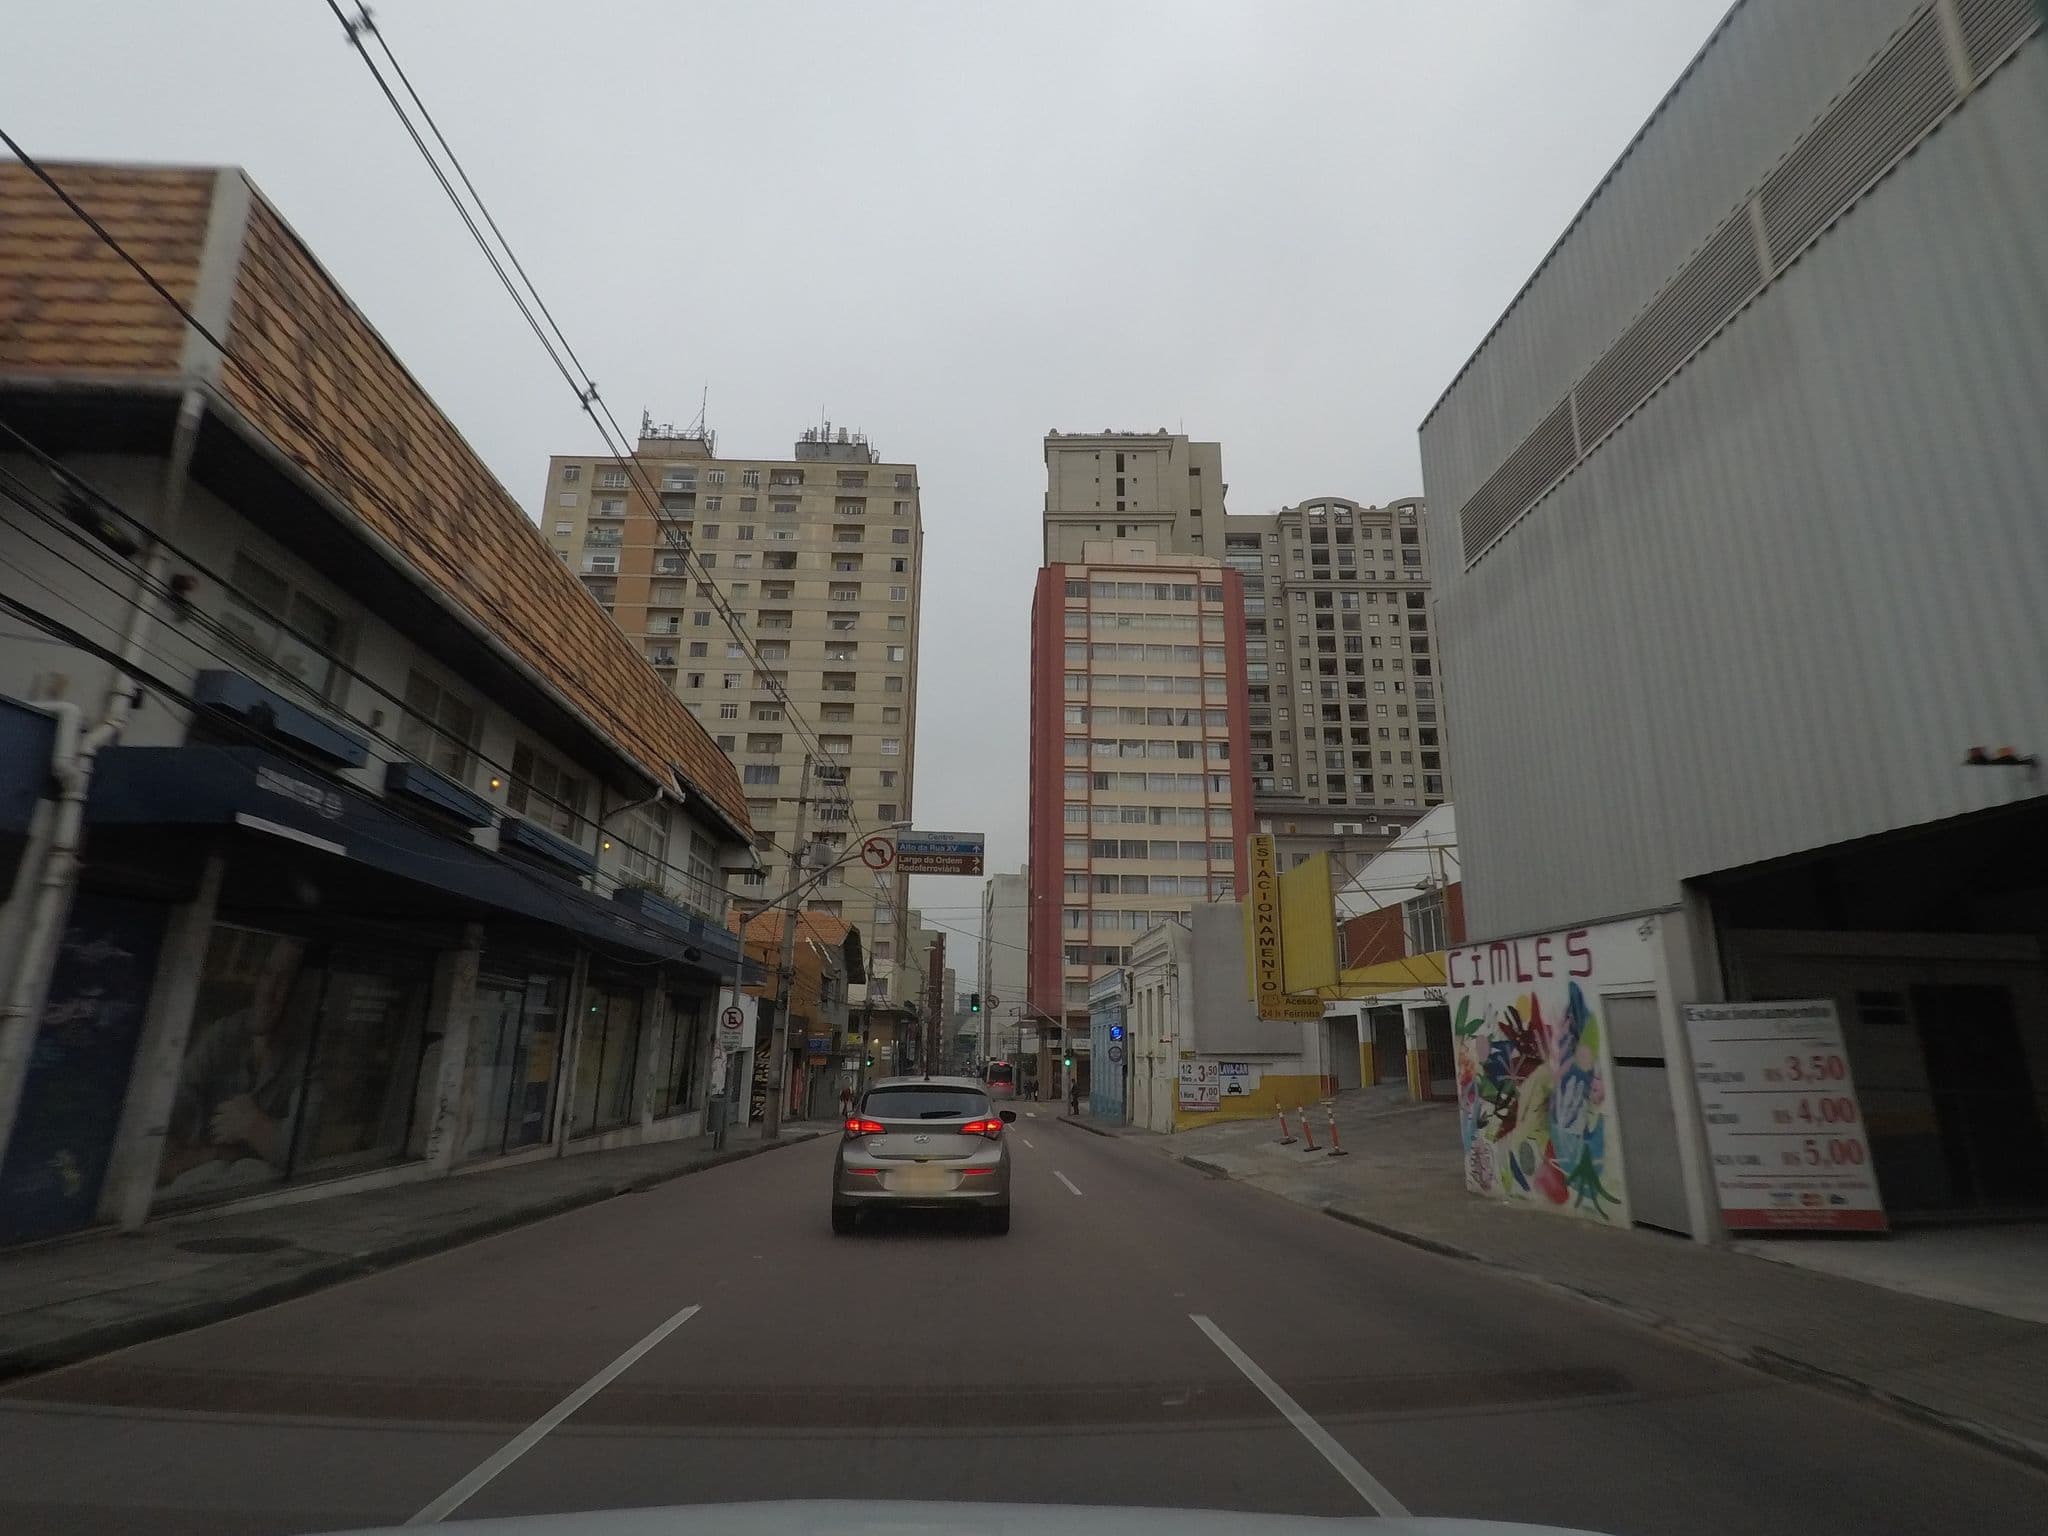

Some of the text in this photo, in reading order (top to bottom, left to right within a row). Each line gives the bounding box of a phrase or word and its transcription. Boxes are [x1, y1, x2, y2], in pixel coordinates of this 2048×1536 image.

[928, 833, 954, 841] Centro
[930, 843, 945, 851] Rua
[899, 856, 922, 865] Largo
[936, 856, 963, 865] Ordem
[898, 864, 960, 872] Rodoferroviária
[1256, 837, 1277, 991] ESTACIONAMENTO
[1285, 998, 1318, 1006] Acesso
[1261, 1009, 1273, 1018] 24
[1284, 1009, 1320, 1019] Feirinha
[1182, 1064, 1192, 1074] 1/2
[1220, 1064, 1249, 1075] LAVA-CAR
[1198, 1065, 1218, 1083] 3,50
[1198, 1086, 1219, 1101] 7,00
